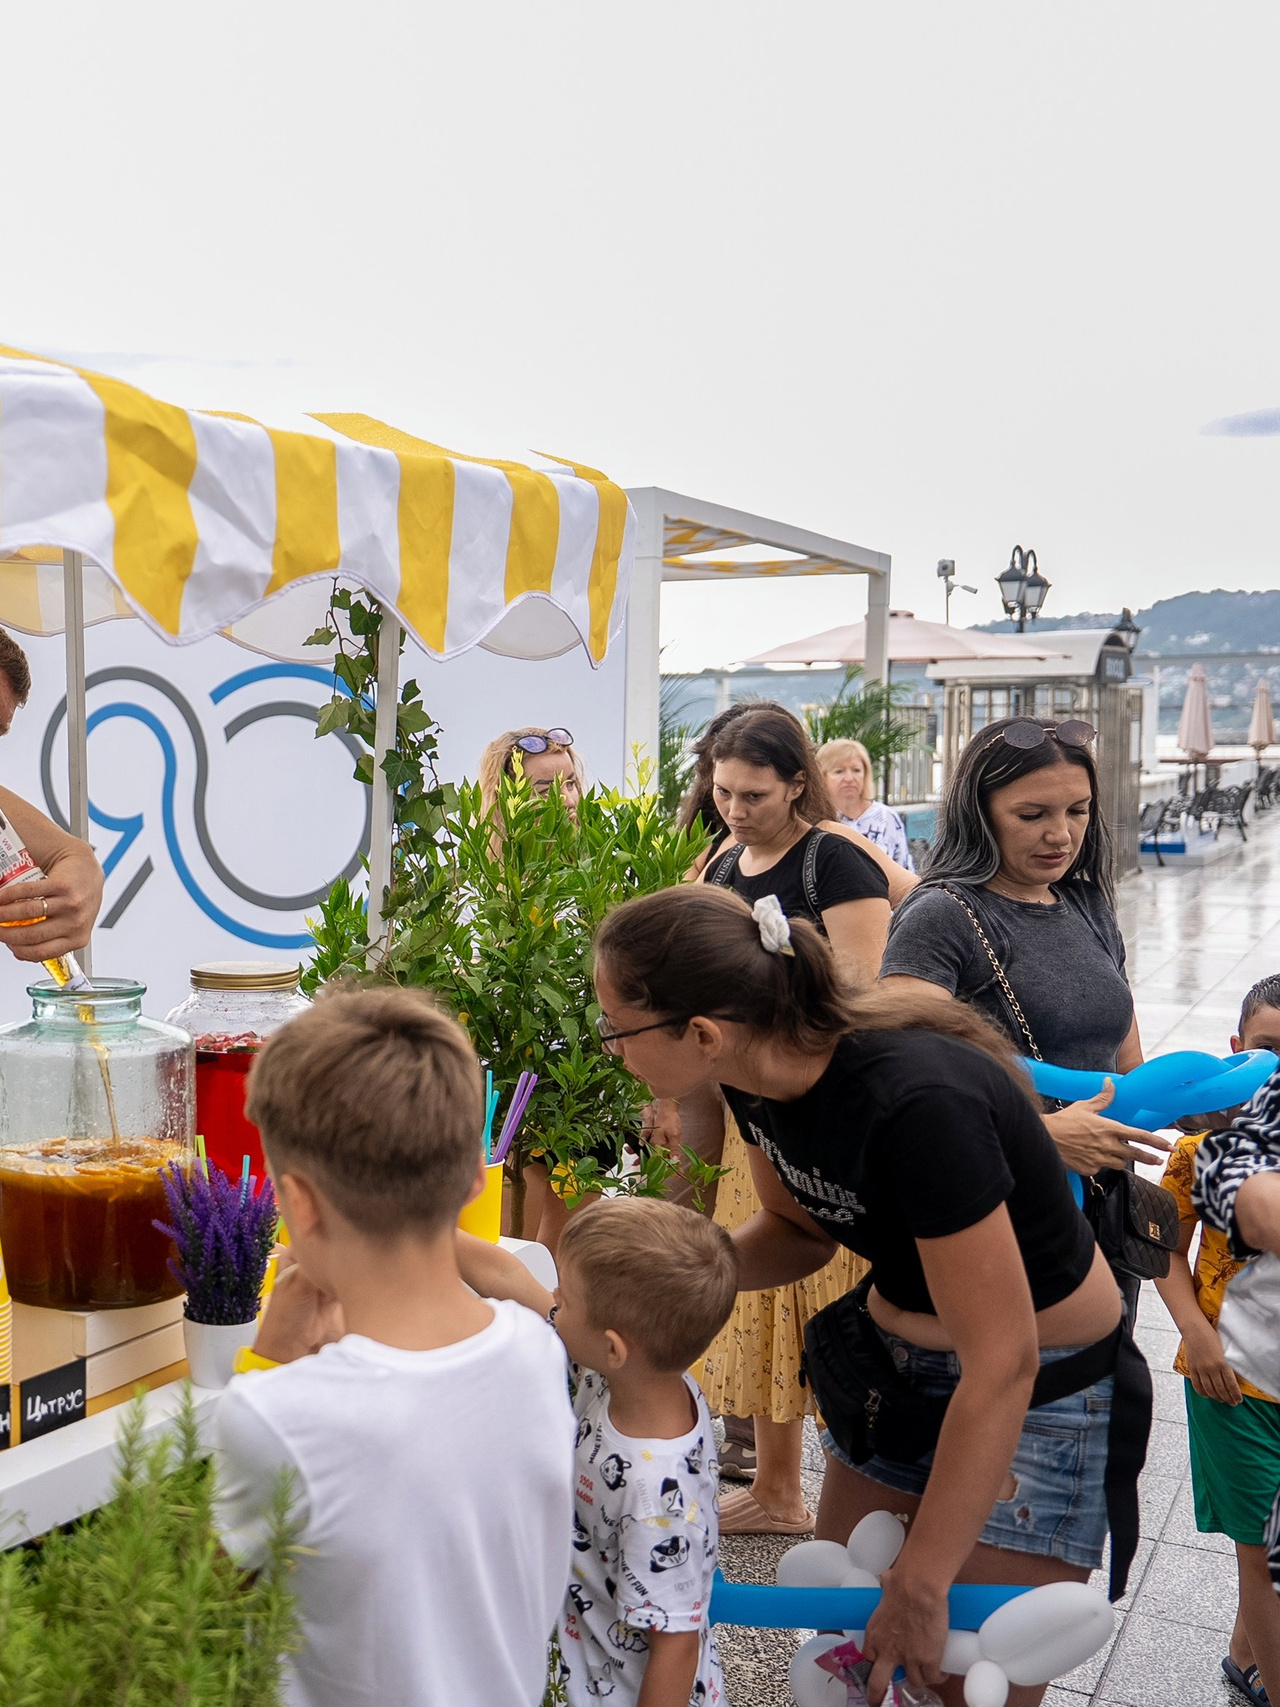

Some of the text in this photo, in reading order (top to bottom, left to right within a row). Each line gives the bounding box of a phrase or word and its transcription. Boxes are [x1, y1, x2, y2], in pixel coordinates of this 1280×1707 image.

[1, 838, 13, 851] WB
[805, 868, 819, 905] GUESS
[625, 1571, 637, 1582] IT
[631, 1580, 649, 1597] FUN
